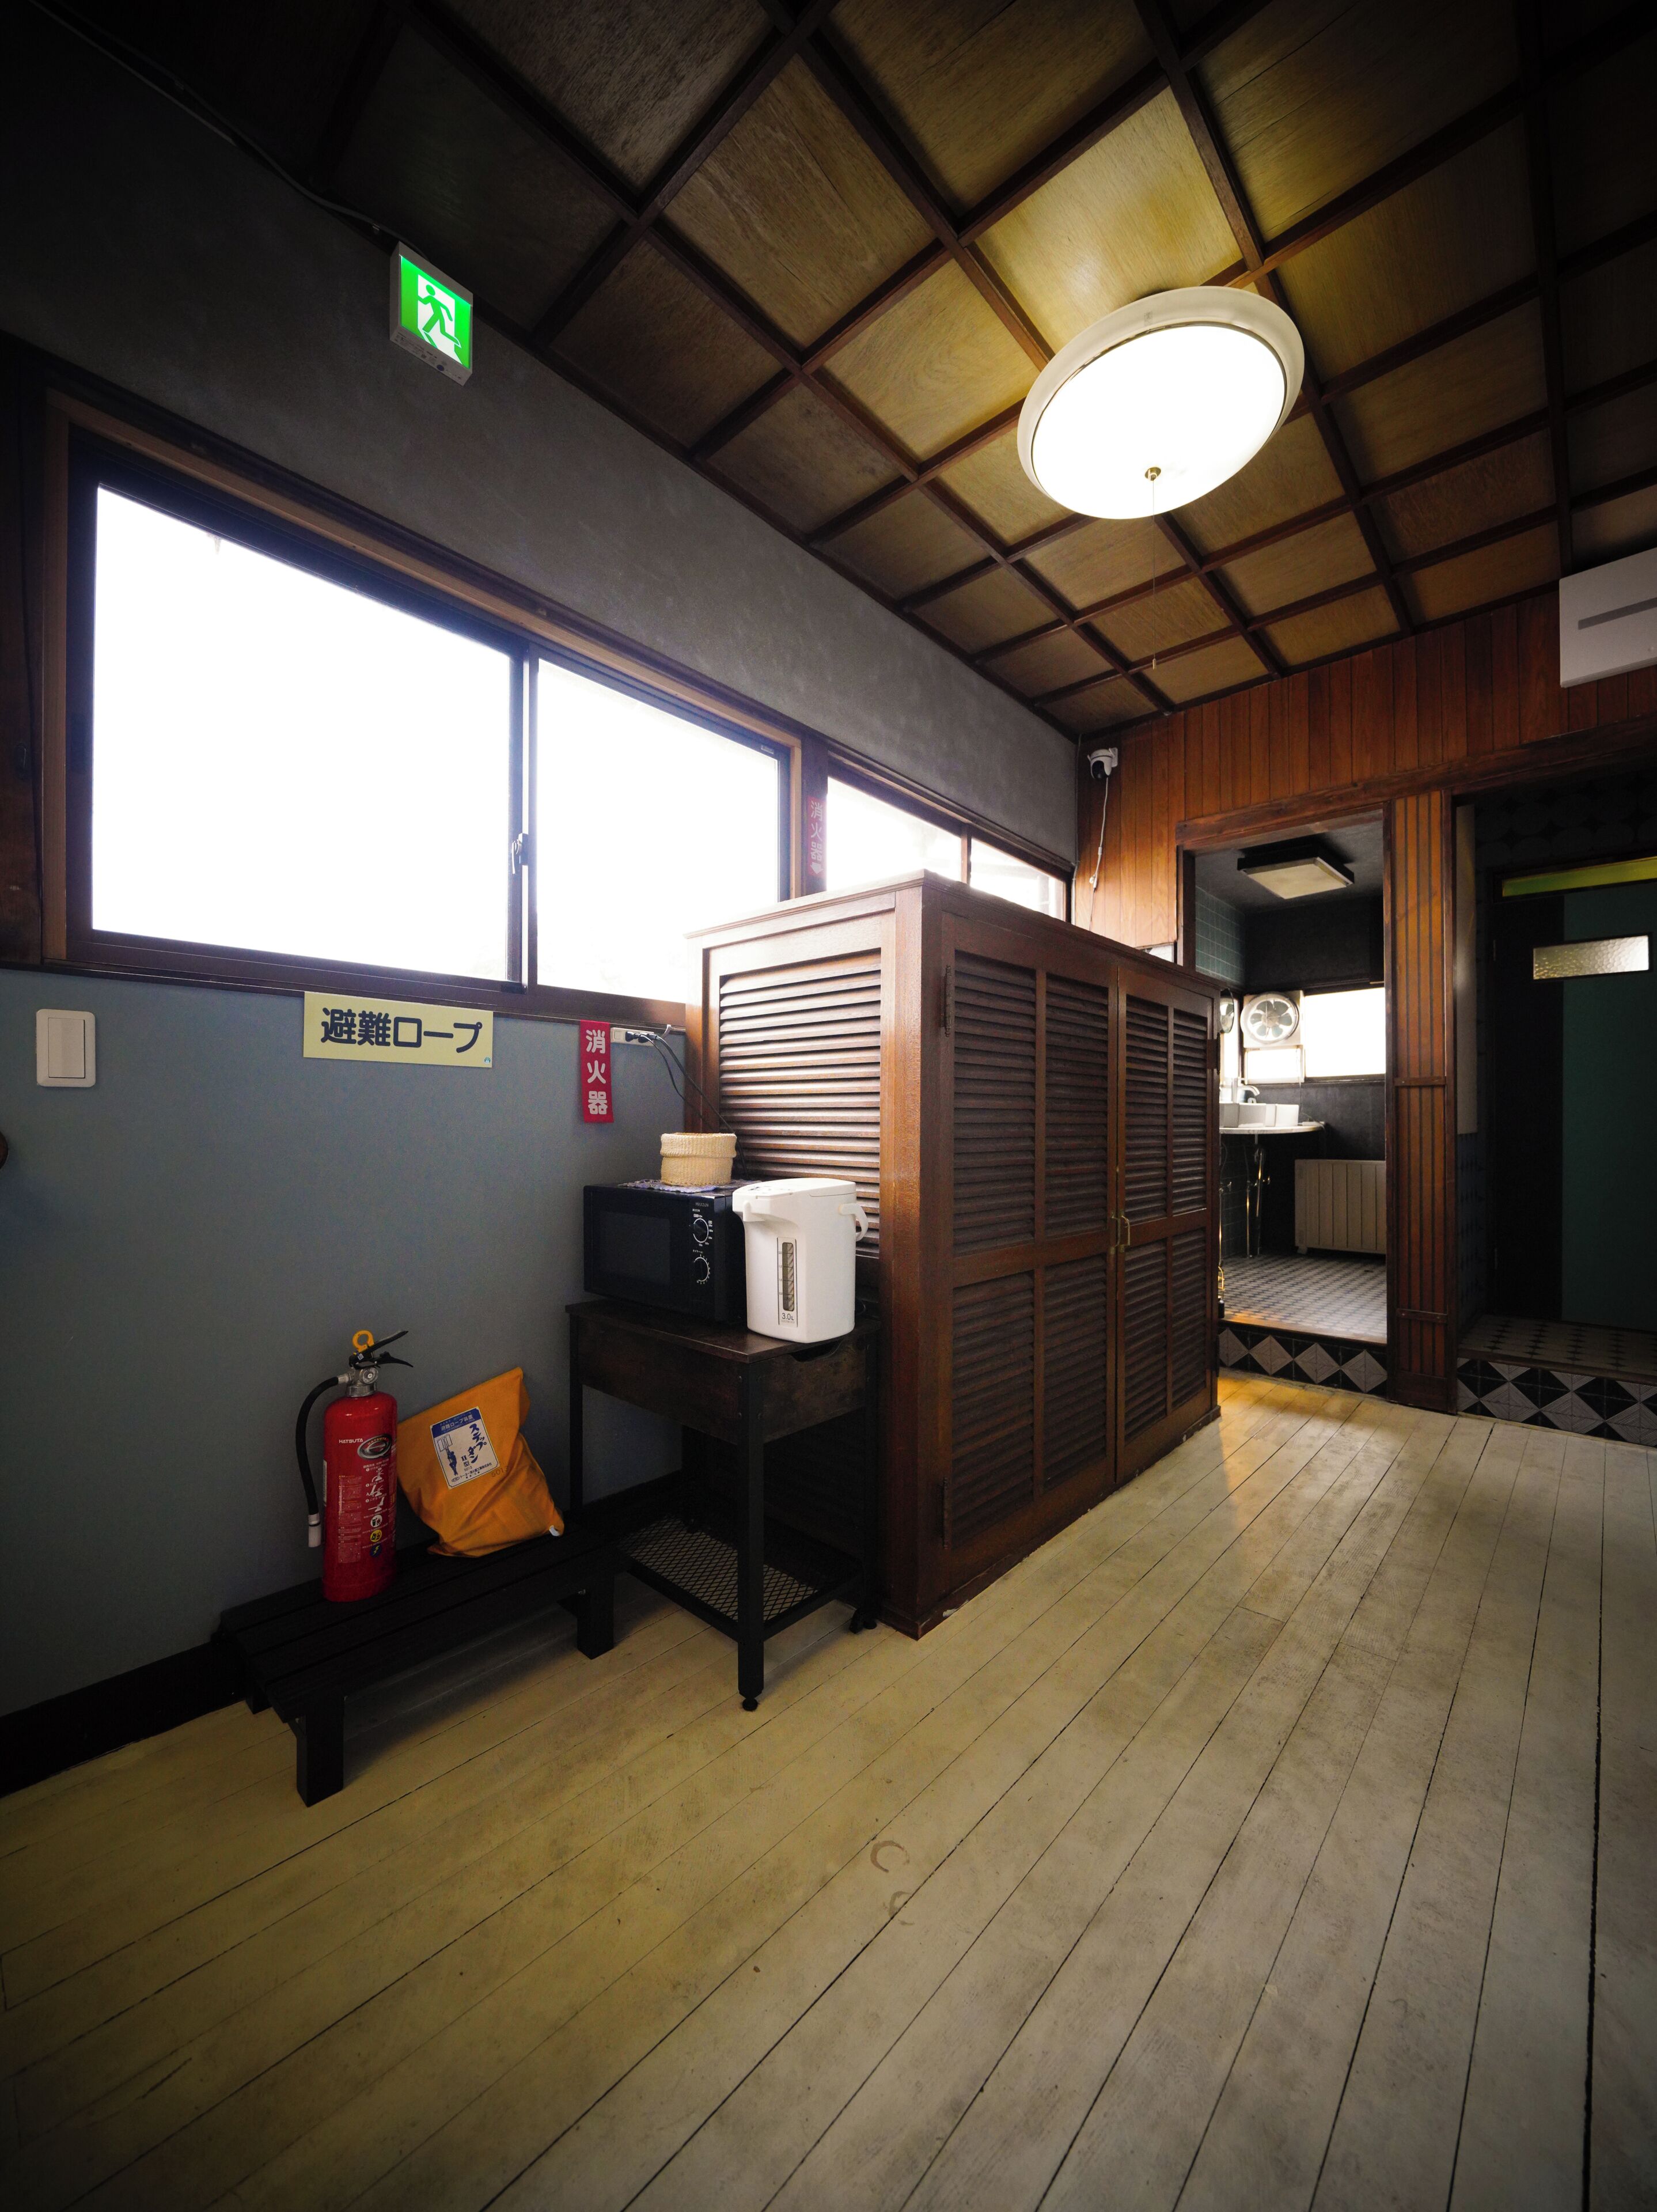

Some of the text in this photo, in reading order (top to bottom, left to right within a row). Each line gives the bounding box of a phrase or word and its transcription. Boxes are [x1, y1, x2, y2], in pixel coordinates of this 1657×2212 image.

[810, 800, 823, 861] 消火器
[320, 1007, 483, 1053] 避難ロープ
[585, 1029, 608, 1115] 消火器
